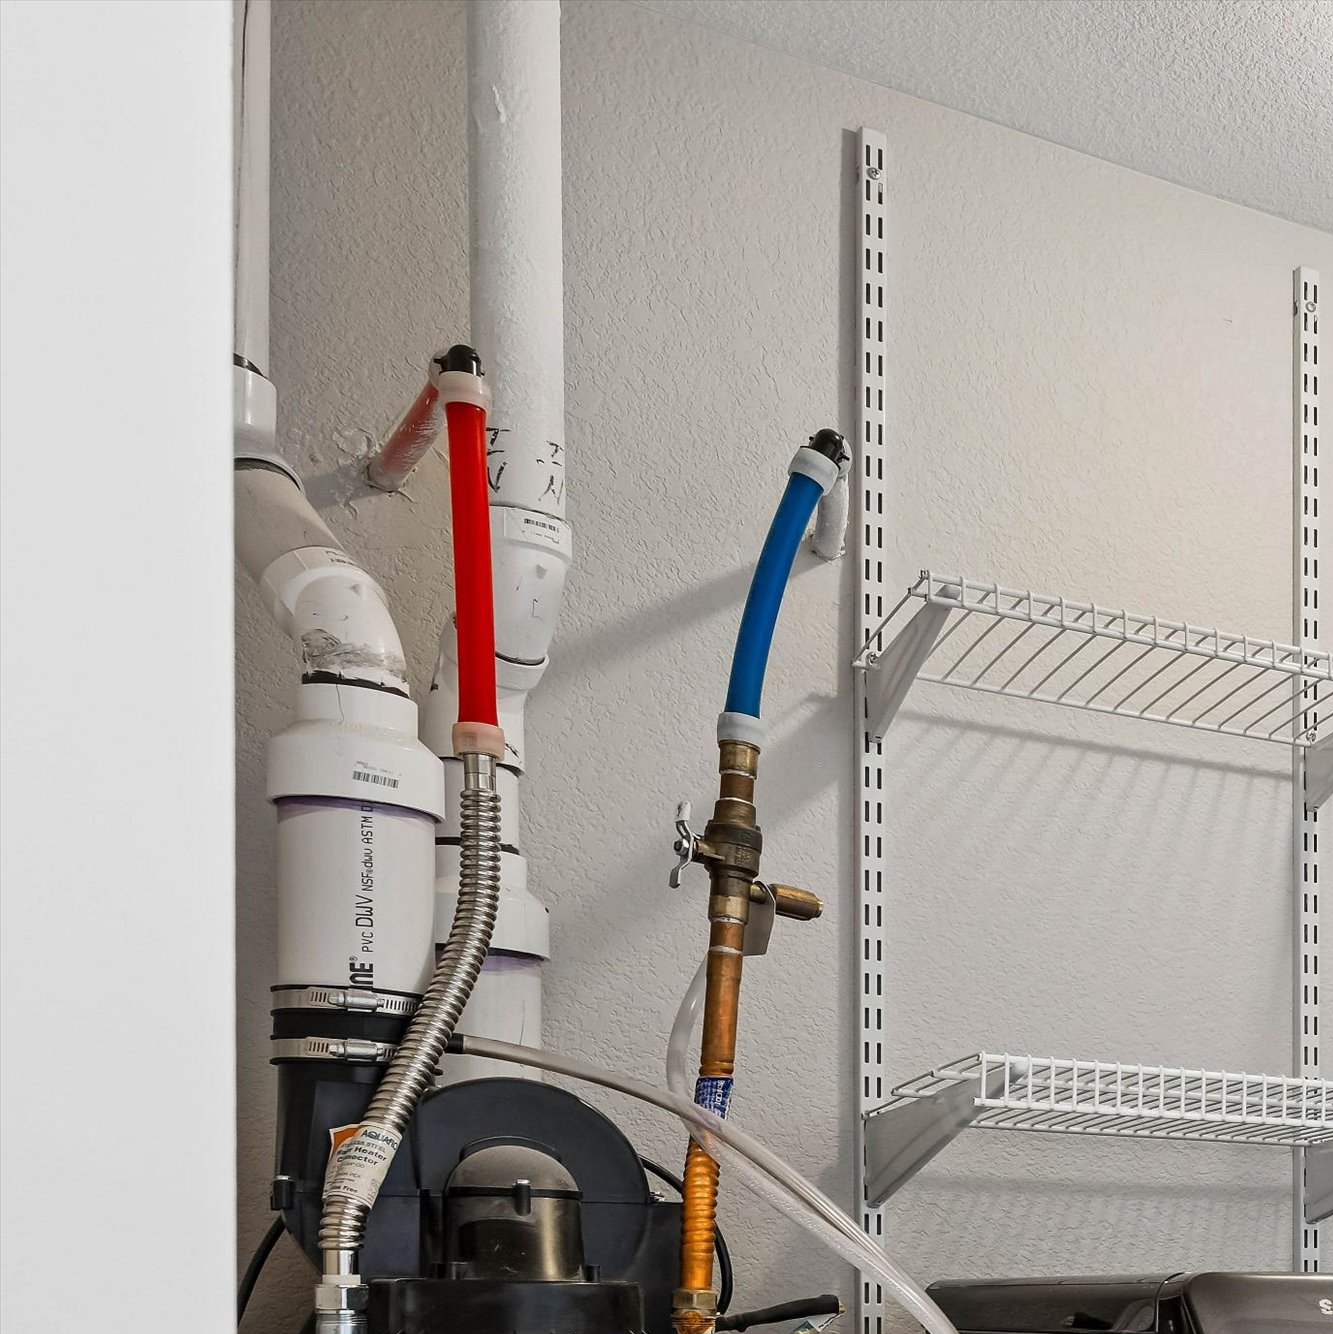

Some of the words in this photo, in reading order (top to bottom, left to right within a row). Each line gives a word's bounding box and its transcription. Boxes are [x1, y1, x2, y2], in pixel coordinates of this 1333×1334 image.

[361, 816, 373, 844] ASTM
[355, 895, 373, 927] DWV
[362, 932, 373, 952] PVC
